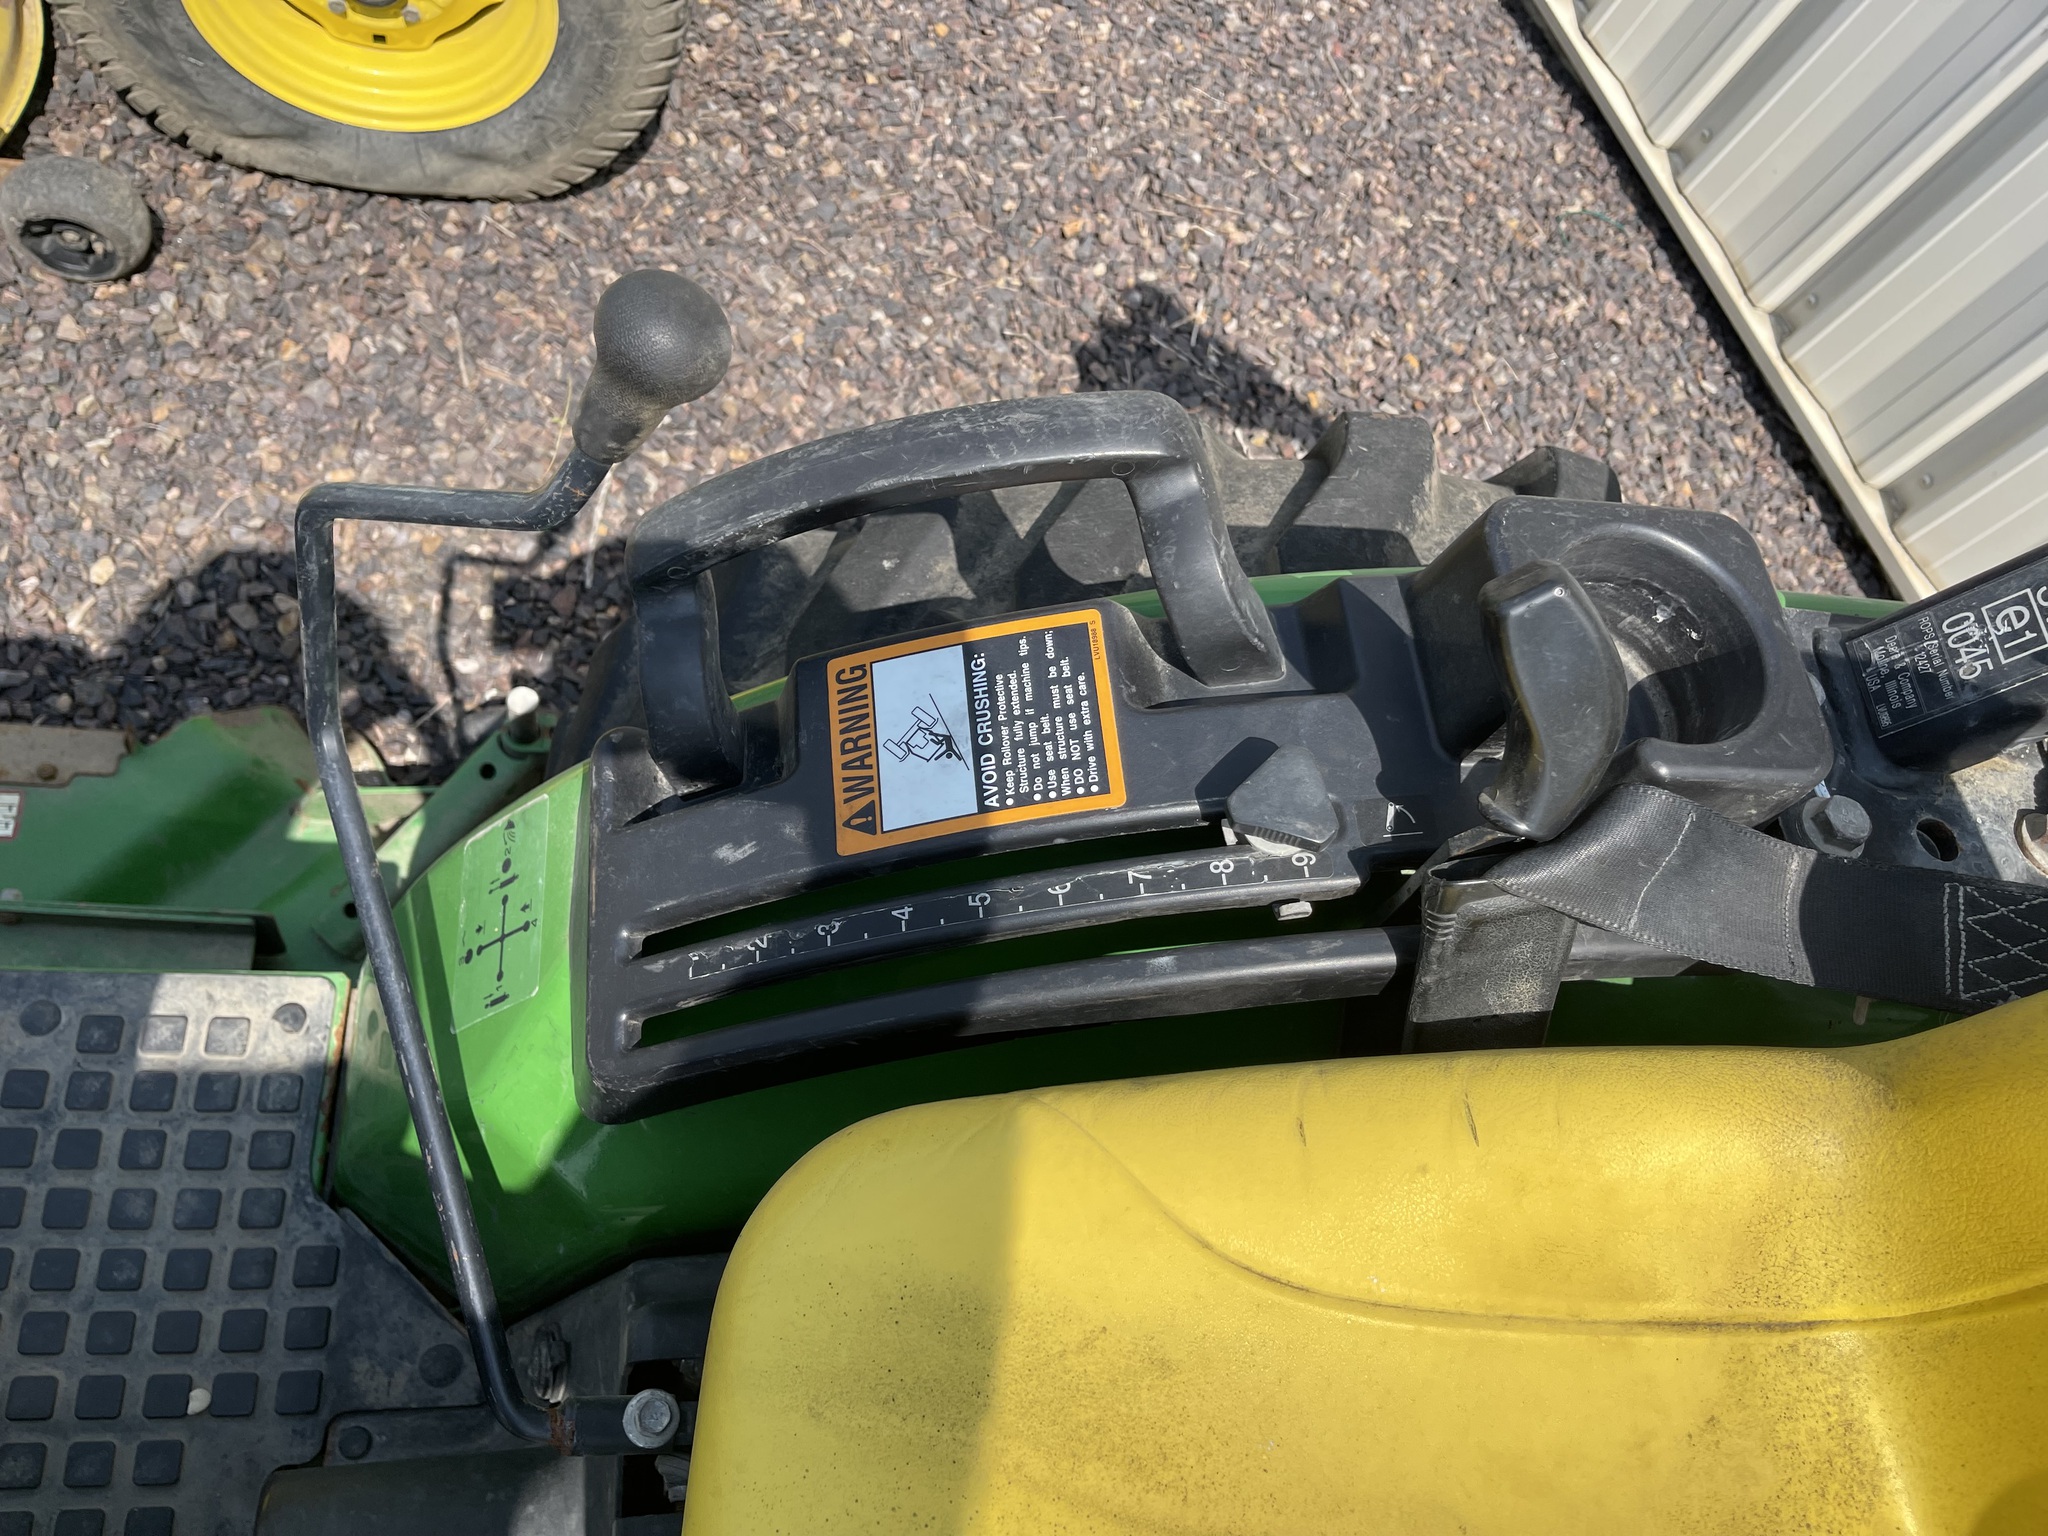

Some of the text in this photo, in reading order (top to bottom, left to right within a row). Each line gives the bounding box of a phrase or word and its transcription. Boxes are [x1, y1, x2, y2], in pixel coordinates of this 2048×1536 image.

[1018, 635, 1030, 657] tips.
[1942, 612, 1994, 680] 0045
[1914, 652, 1932, 674] 12427
[1918, 616, 1935, 643] ROPS
[1937, 669, 1955, 700] Number
[1022, 662, 1034, 701] machine
[1865, 674, 1881, 692] USA
[1874, 646, 1901, 709] Moline, Illinois
[1885, 635, 1918, 709] Deere & Company
[1045, 630, 1072, 797] When structure must be down;
[1060, 656, 1085, 784] DO NOT use seat belt.
[835, 663, 875, 805] WARNING
[971, 652, 1000, 807] AVOID CRUSHING:
[994, 673, 1016, 796] Keep Rollover Protective
[1009, 670, 1029, 794] Structure fully extended.
[1029, 722, 1041, 746] jump
[1077, 672, 1099, 783] Drive with extra care.
[1031, 752, 1041, 770] not
[1040, 713, 1057, 789] Use seat belt.
[1033, 776, 1043, 791] Do
[505, 847, 512, 856] 2
[1291, 851, 1317, 867] 9
[1127, 869, 1152, 884] 7
[1209, 858, 1234, 874] 8
[968, 892, 991, 907] 5
[1047, 882, 1071, 895] 6
[531, 918, 538, 928] 4
[892, 906, 913, 920] 4
[817, 920, 839, 936] 3
